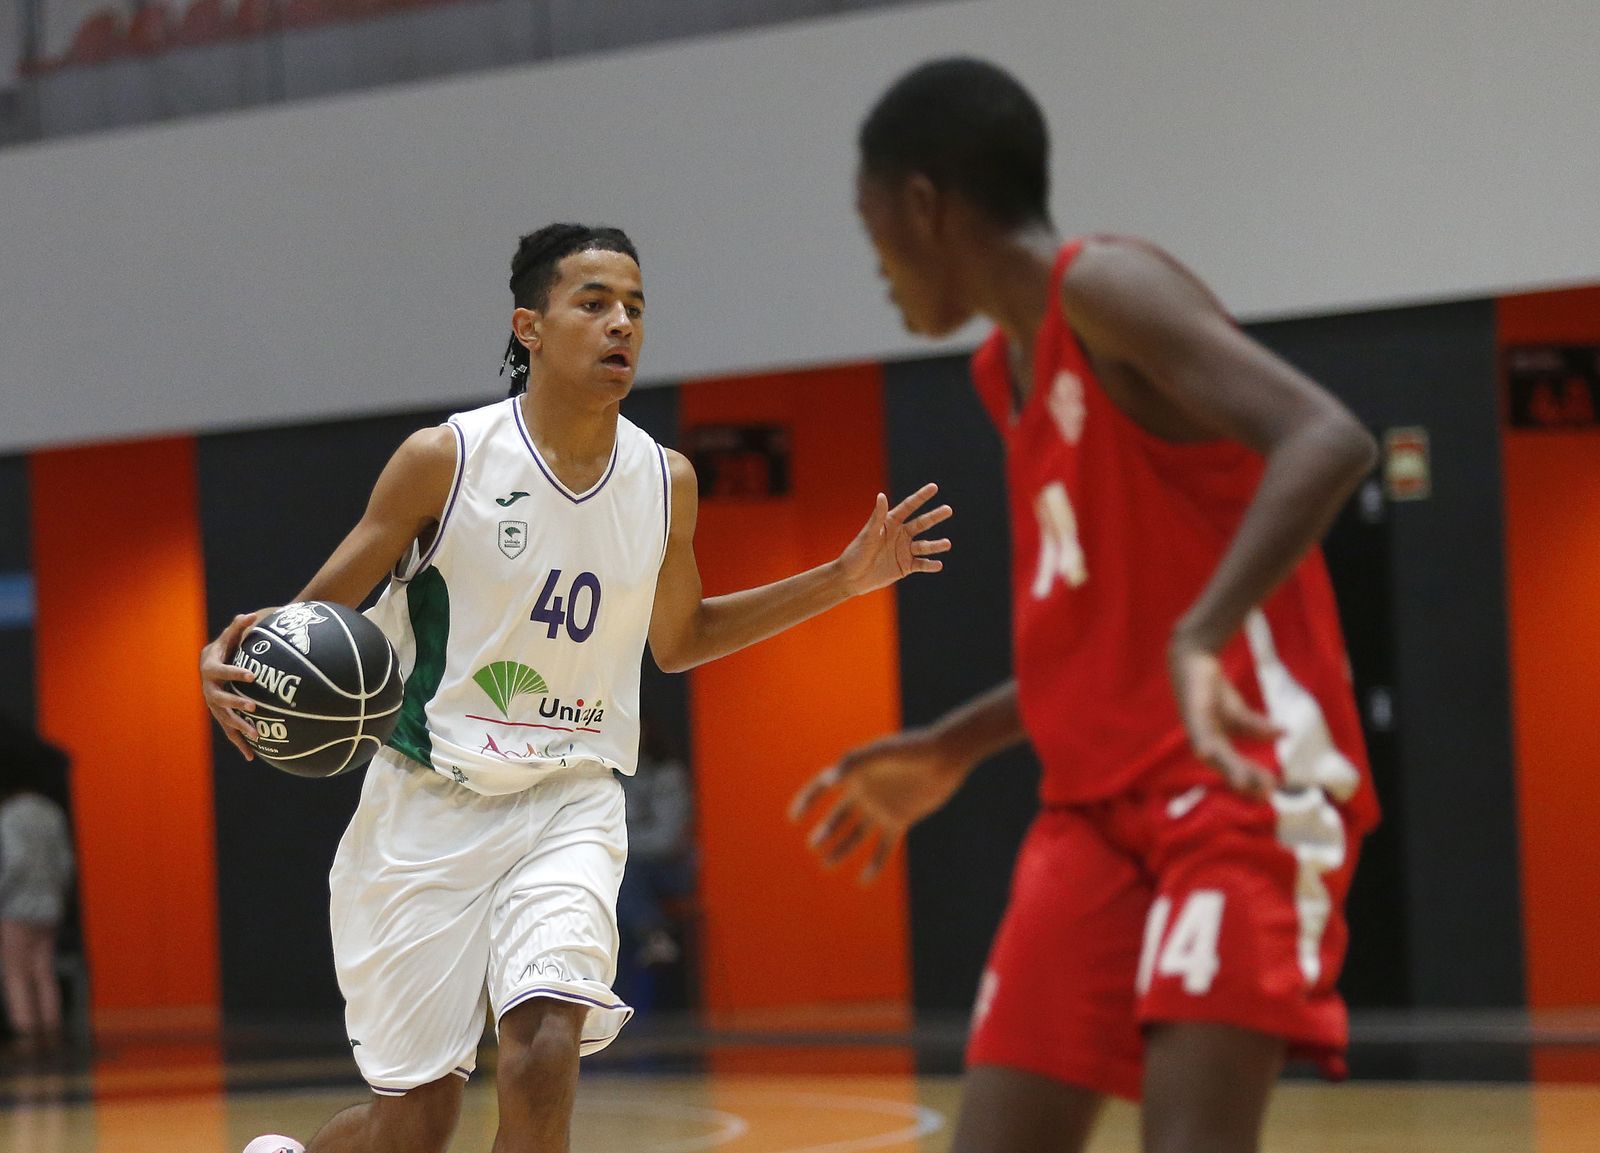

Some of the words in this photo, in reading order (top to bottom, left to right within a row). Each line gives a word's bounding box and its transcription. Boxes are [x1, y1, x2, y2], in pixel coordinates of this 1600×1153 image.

[530, 568, 602, 643] 40
[232, 648, 302, 704] PALDING
[538, 697, 605, 726] Uniaja
[1136, 889, 1225, 996] 14
